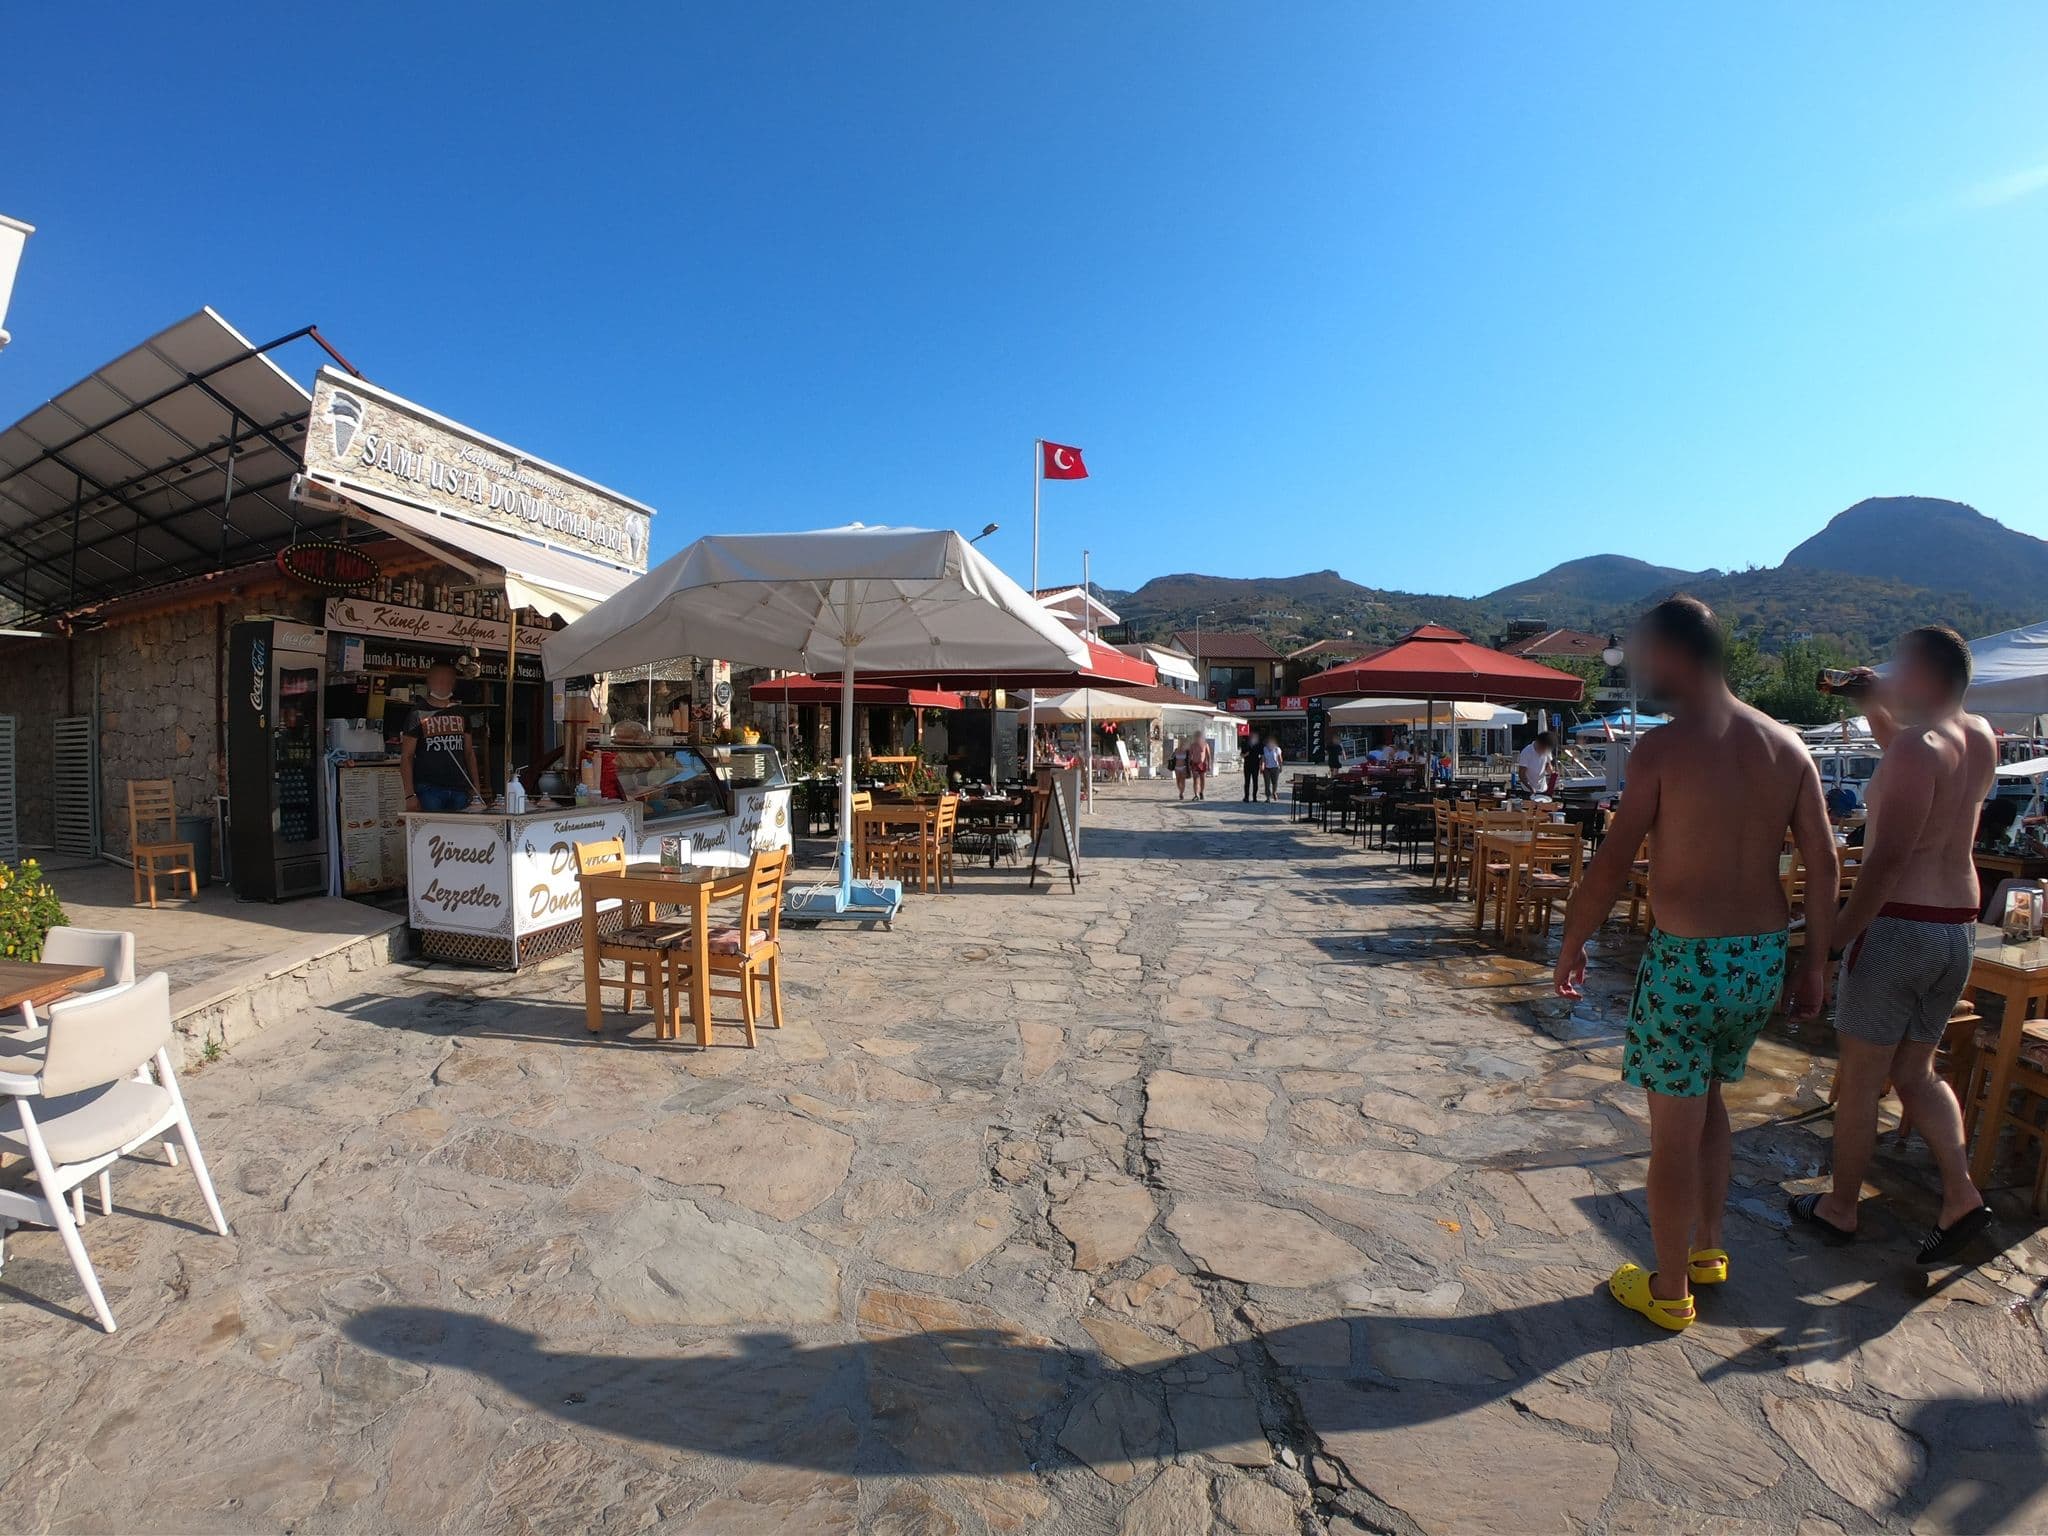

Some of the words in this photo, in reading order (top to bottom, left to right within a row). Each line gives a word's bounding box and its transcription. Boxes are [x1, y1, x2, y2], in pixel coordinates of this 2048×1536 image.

[362, 435, 425, 484] SAMİ
[430, 459, 484, 505] USTA
[489, 482, 623, 553] DONDURMALARI
[373, 607, 431, 637] Künefe
[447, 619, 497, 641] Lokma
[364, 651, 393, 666] umda
[394, 652, 417, 668] Türk
[426, 715, 464, 735] HYPER
[1312, 722, 1321, 754] REEF
[428, 835, 496, 868] Yöresel
[693, 829, 726, 854] Meyveli
[421, 878, 502, 912] Lezzetler
